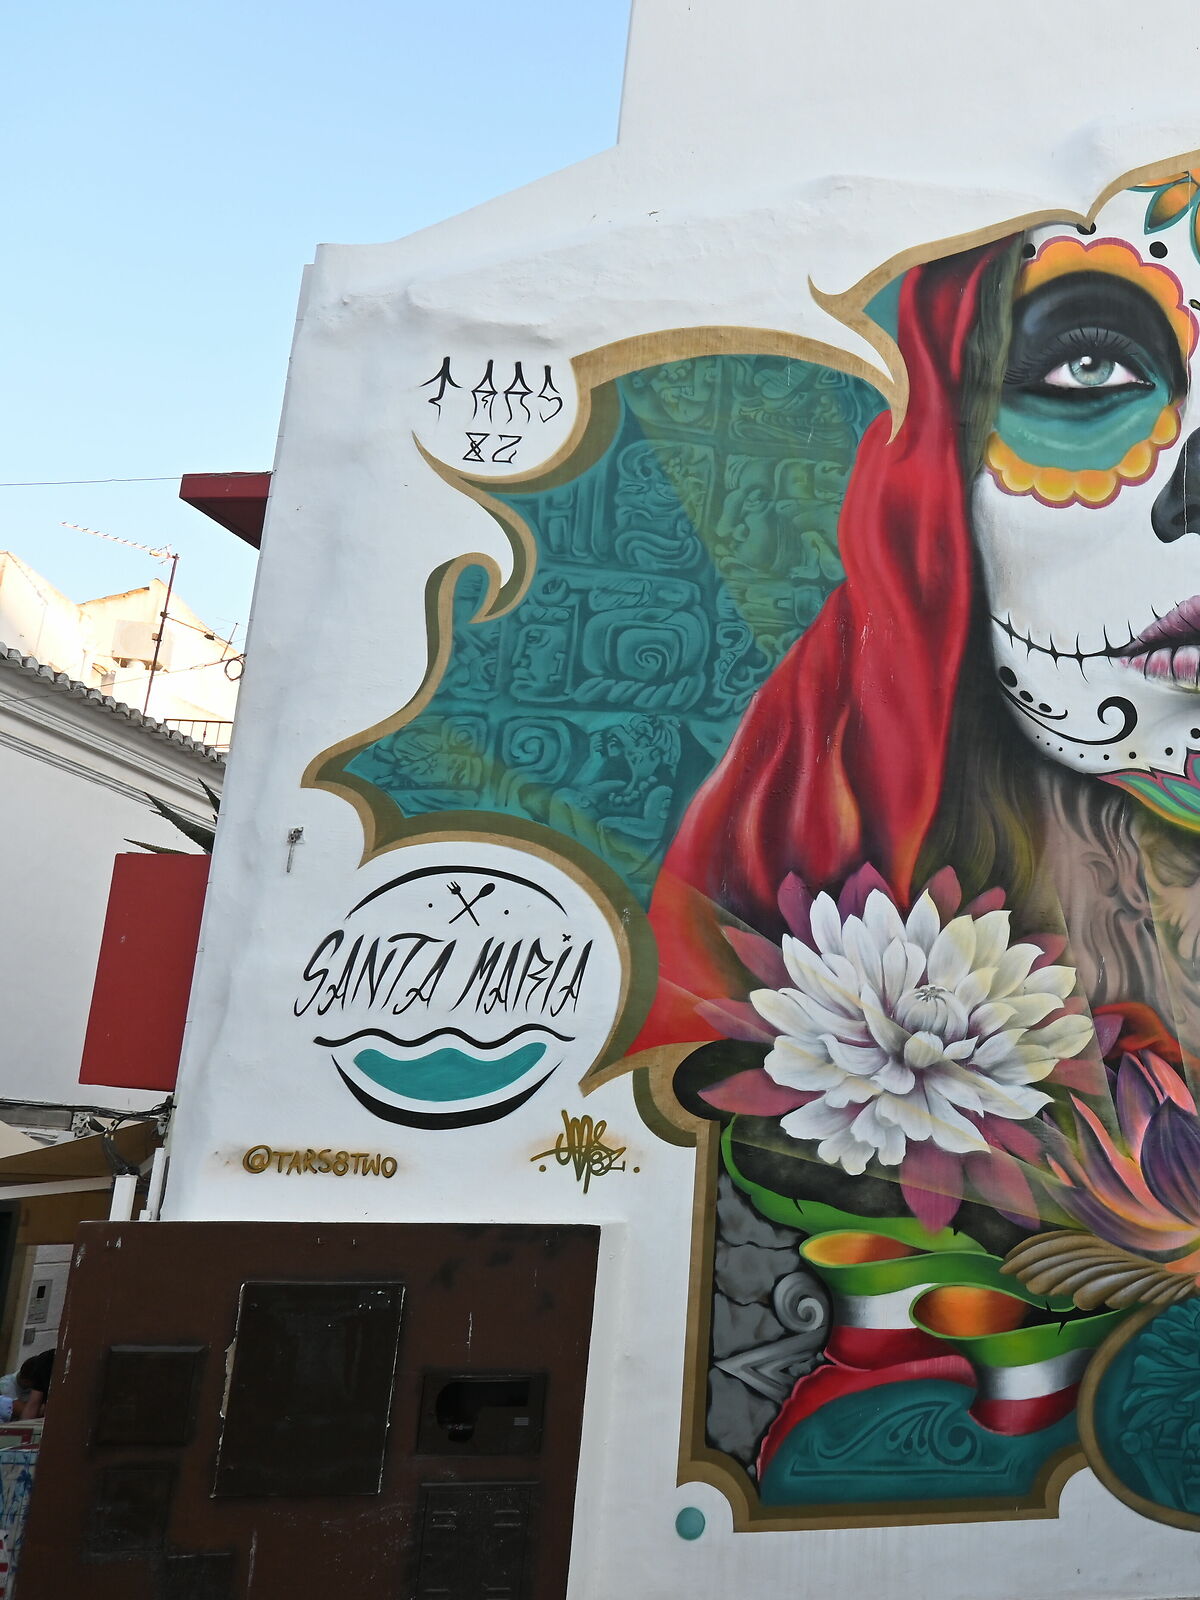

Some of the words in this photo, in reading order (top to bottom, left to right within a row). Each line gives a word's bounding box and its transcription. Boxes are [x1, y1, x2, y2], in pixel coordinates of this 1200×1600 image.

[293, 929, 457, 1017] SANTA
[450, 933, 594, 1017] MARIA
[242, 1144, 398, 1179] @TARS8TWO
